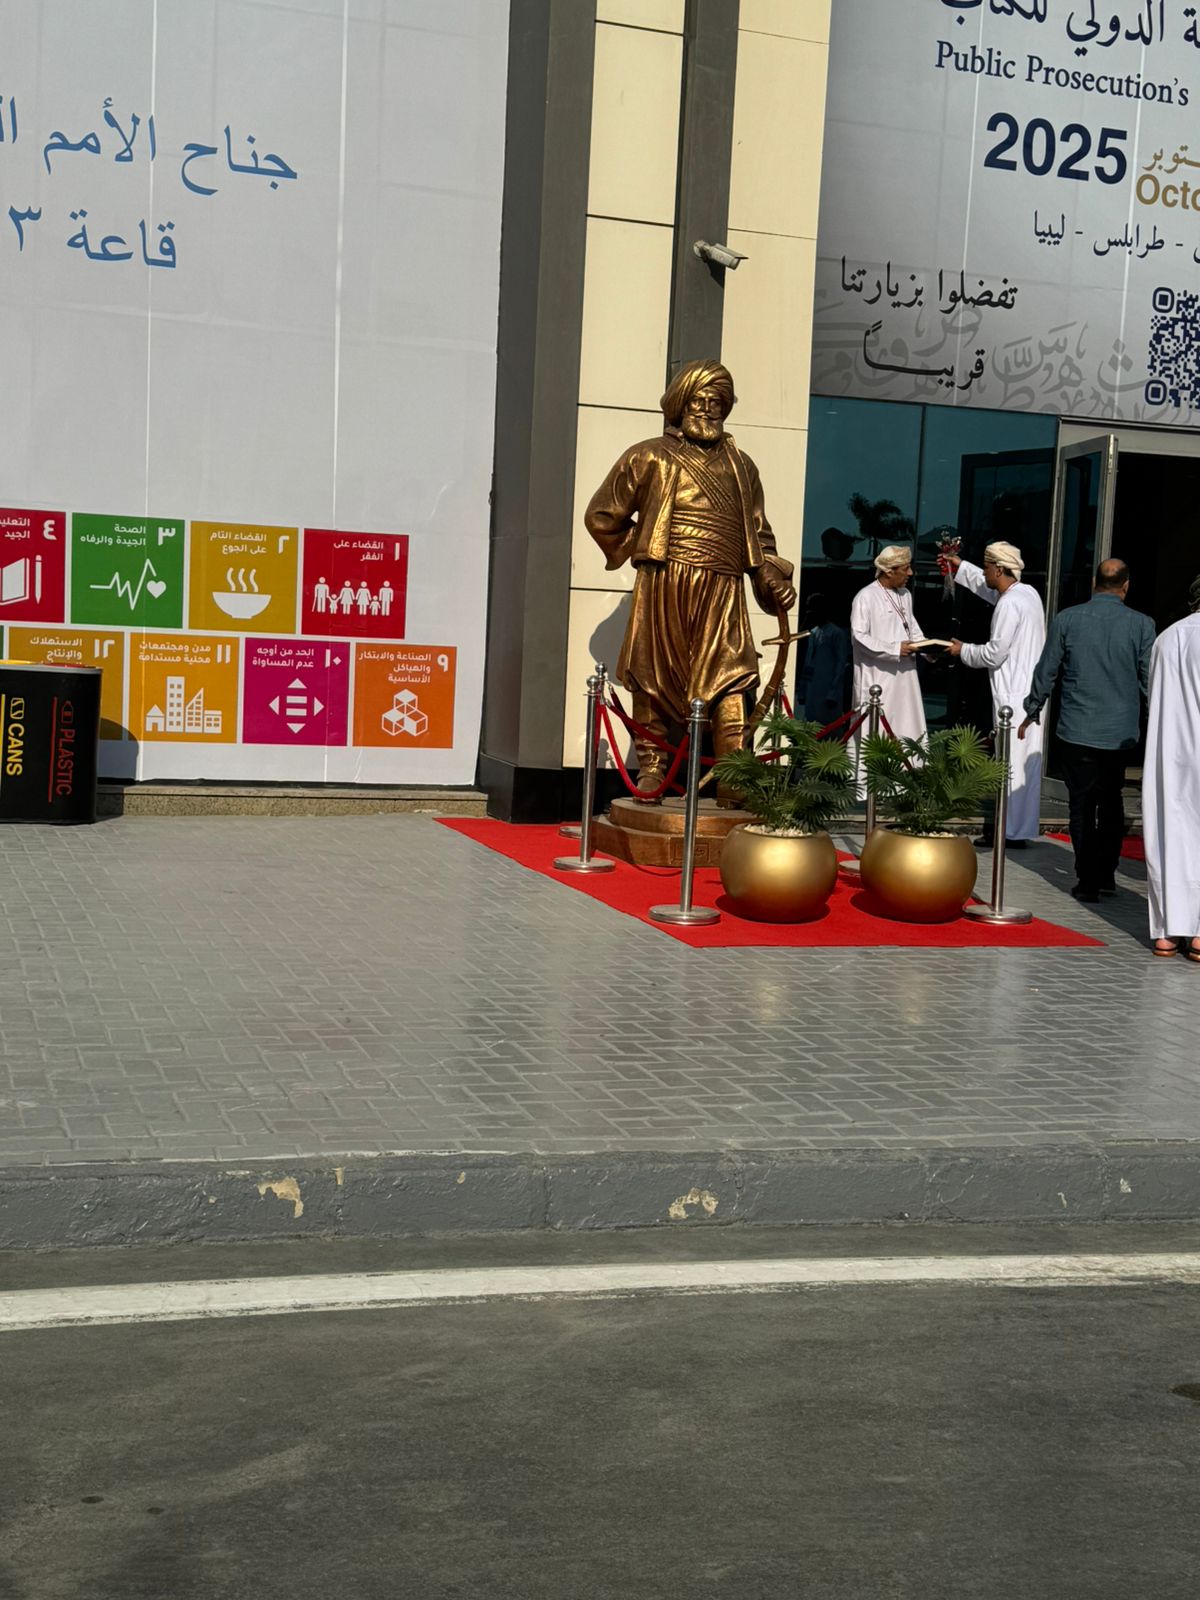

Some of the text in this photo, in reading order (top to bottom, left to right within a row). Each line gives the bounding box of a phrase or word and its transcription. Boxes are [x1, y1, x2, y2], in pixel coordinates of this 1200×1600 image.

[935, 40, 1189, 106] Public Prosecution's
[43, 97, 157, 175] الأمم
[984, 112, 1128, 184] 2025
[180, 125, 298, 196] جناح
[1034, 209, 1066, 246] ليبيا
[8, 206, 176, 269] قاعة ٣
[1093, 224, 1165, 259] طرابلس
[841, 255, 1019, 315] تفضلوا بزيارتنا
[0, 516, 31, 528] التعلي
[43, 519, 57, 540] ٤
[114, 523, 147, 534] الصحة
[4, 530, 31, 541] الجيد
[79, 534, 147, 547] الجيدة والرفاه
[157, 526, 176, 546] ٣
[209, 530, 267, 542] القضاء التام
[278, 535, 290, 554] ٢
[333, 539, 384, 550] القضاء على
[222, 543, 267, 555] على الجوع
[360, 552, 384, 562] الفقر
[394, 542, 401, 561] ١
[30, 636, 83, 647] الاستهلاك
[93, 638, 115, 658] ١٢
[139, 640, 212, 654] مدن ومجتمعات
[138, 651, 211, 665] محلية مستدامة
[216, 644, 231, 664] ١١
[256, 645, 315, 658] الحد من أوجه
[324, 649, 342, 668] ١٠
[359, 650, 432, 661] الصناعة والابتكار
[252, 656, 314, 669] عدم المساواة
[393, 663, 431, 674] والهياكل
[437, 654, 449, 672] ٩
[387, 673, 431, 684] الأساسية
[6, 723, 25, 776] CANS
[55, 728, 75, 795] PLASTIC
